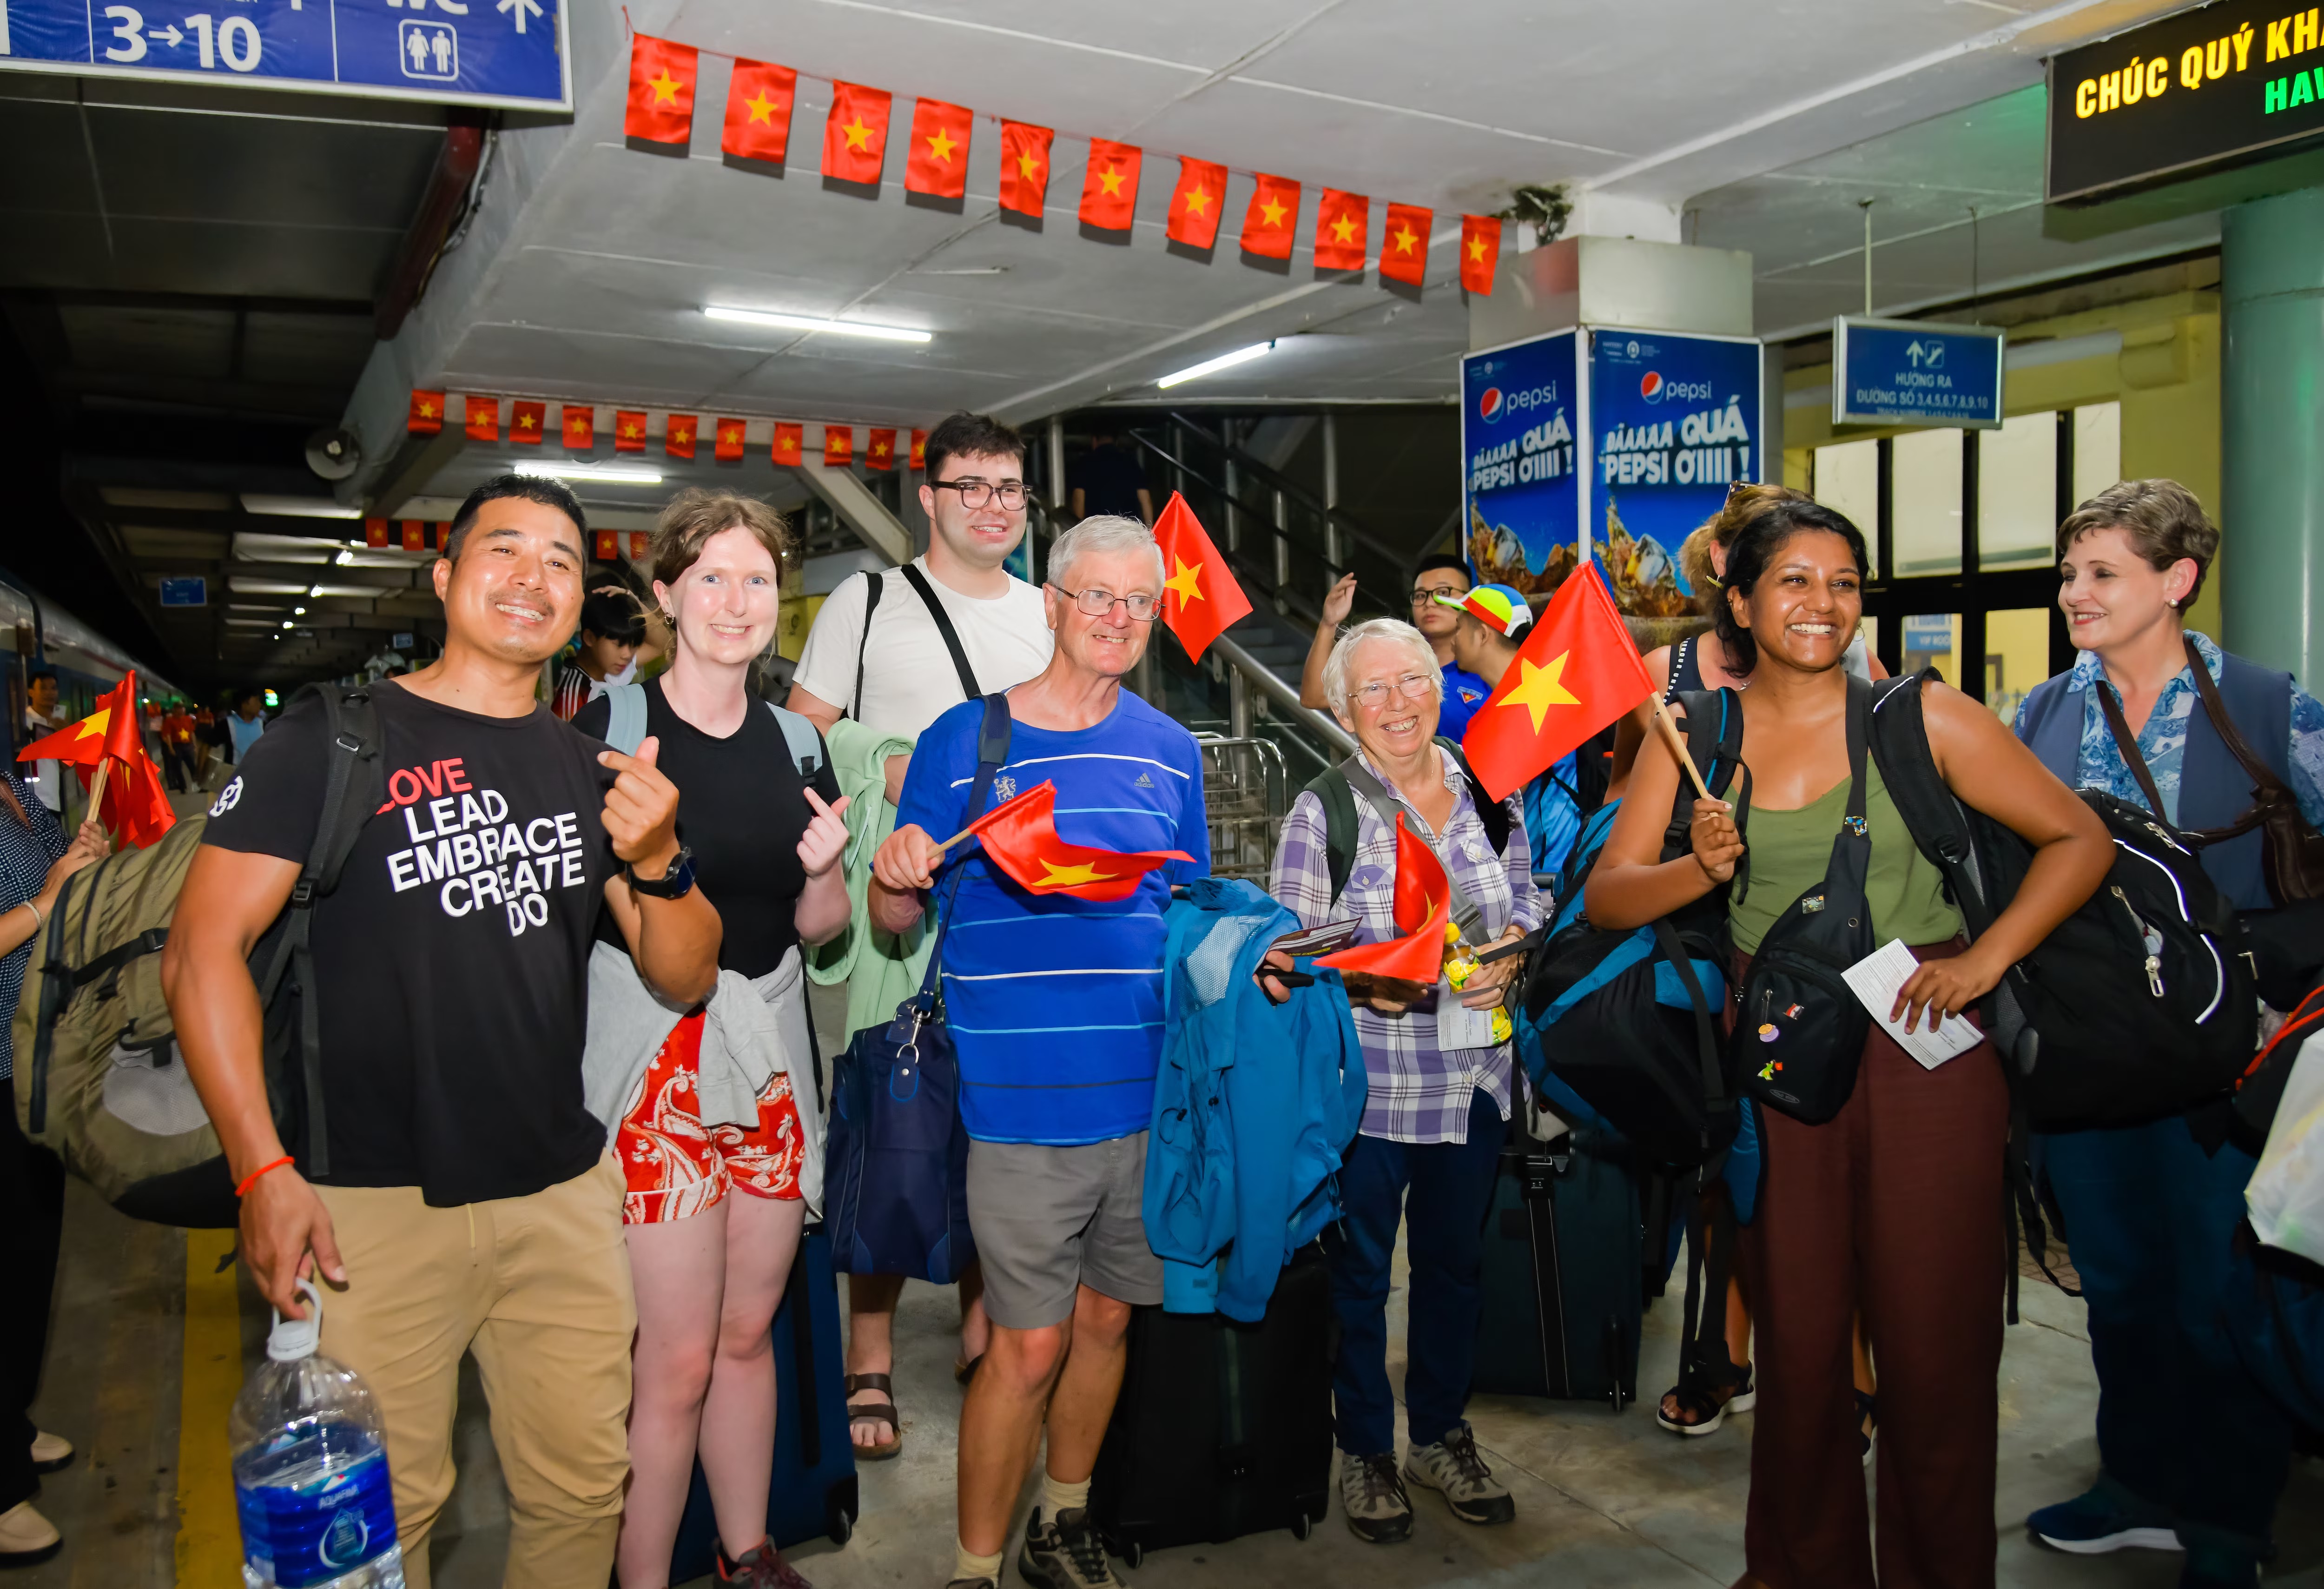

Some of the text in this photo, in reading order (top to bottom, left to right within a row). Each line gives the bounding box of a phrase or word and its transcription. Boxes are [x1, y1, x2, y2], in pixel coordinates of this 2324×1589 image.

[2076, 56, 2168, 119] CHÚC
[2180, 22, 2254, 90] QUÝ
[1507, 380, 1557, 416] pepsi
[1666, 381, 1712, 402] pepsi
[1937, 374, 1952, 388] RA
[1522, 406, 1573, 454] QUÁ
[1681, 394, 1750, 445] QUÁ
[1473, 460, 1515, 492] PEPSI
[1605, 450, 1669, 484] PEPSI
[376, 757, 473, 815] OVE
[1134, 780, 1154, 788] adidas
[404, 789, 508, 843] LEAD
[387, 812, 582, 892] EMBRACE
[441, 849, 585, 917] CREATE
[506, 893, 548, 937] DO
